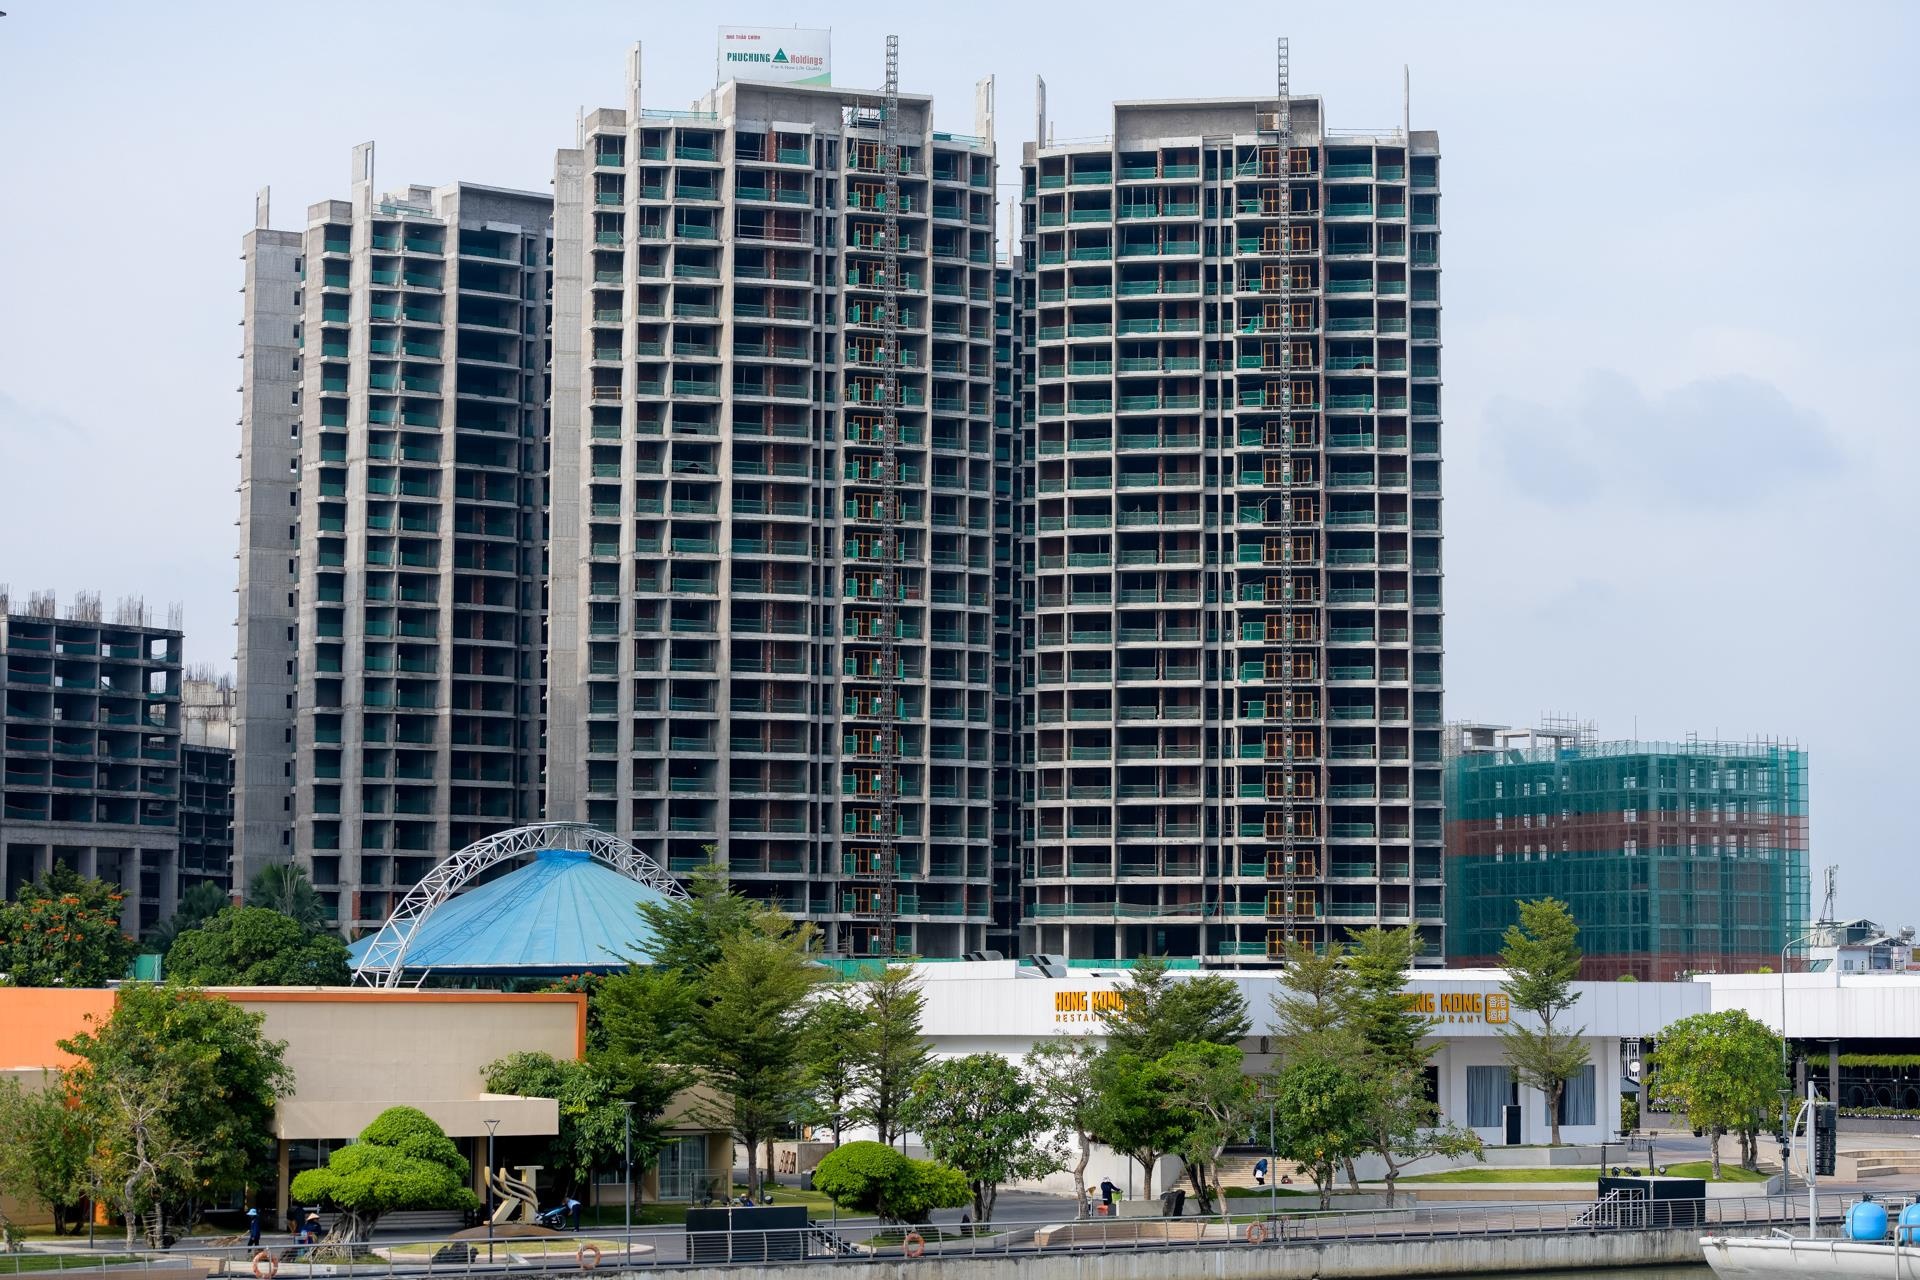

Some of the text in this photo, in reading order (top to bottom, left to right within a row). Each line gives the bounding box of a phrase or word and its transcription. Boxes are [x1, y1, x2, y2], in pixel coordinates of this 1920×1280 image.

[727, 52, 823, 66] PHUCHUNG Holdings
[1055, 991, 1088, 1012] HONG
[1091, 991, 1125, 1012] KONG
[1441, 993, 1483, 1013] KONG
